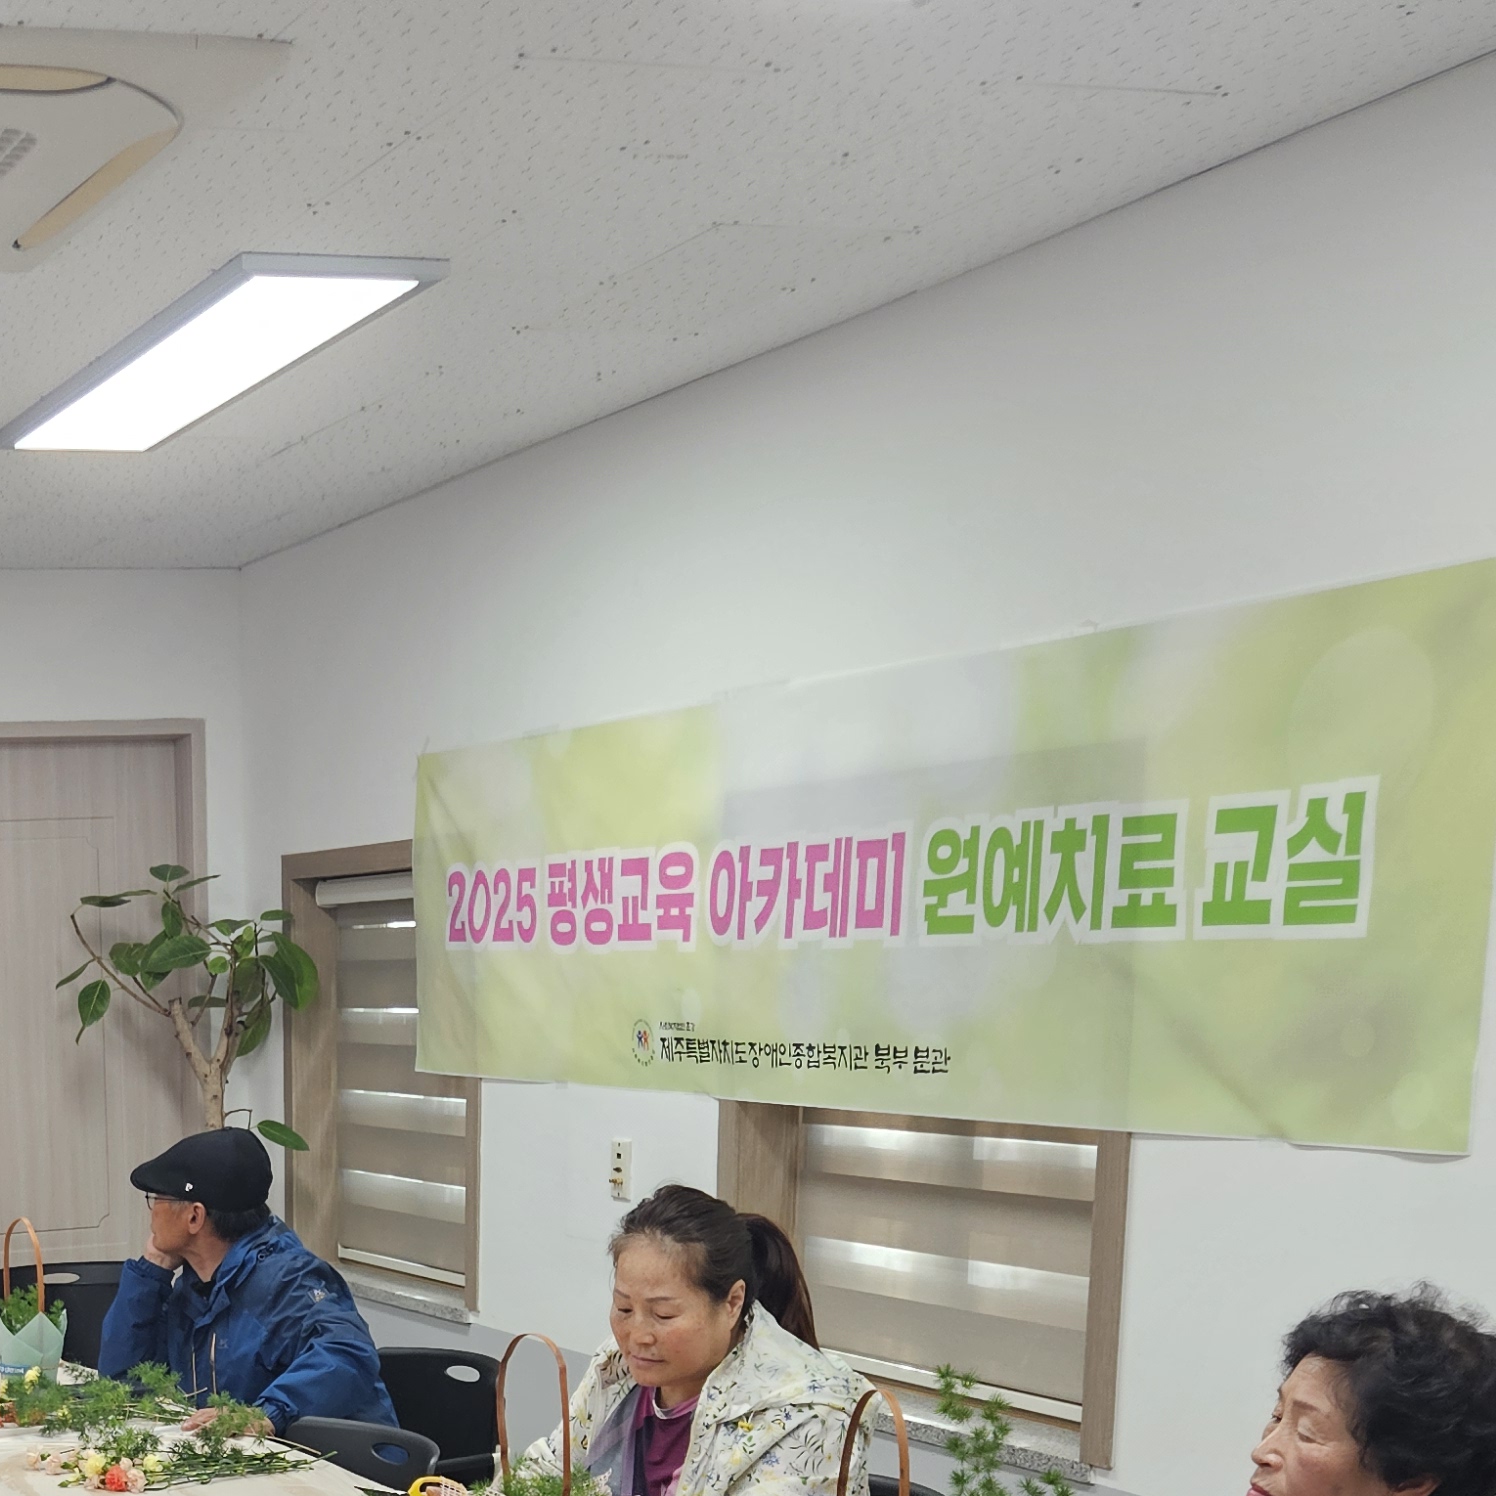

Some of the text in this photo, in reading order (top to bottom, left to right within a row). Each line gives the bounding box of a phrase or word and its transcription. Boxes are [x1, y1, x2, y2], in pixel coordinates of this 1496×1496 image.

[447, 791, 1367, 945] 2025 평생교육 아카데미 원예치료 교실
[875, 1043, 908, 1074] 북부
[913, 1046, 951, 1074] 분관
